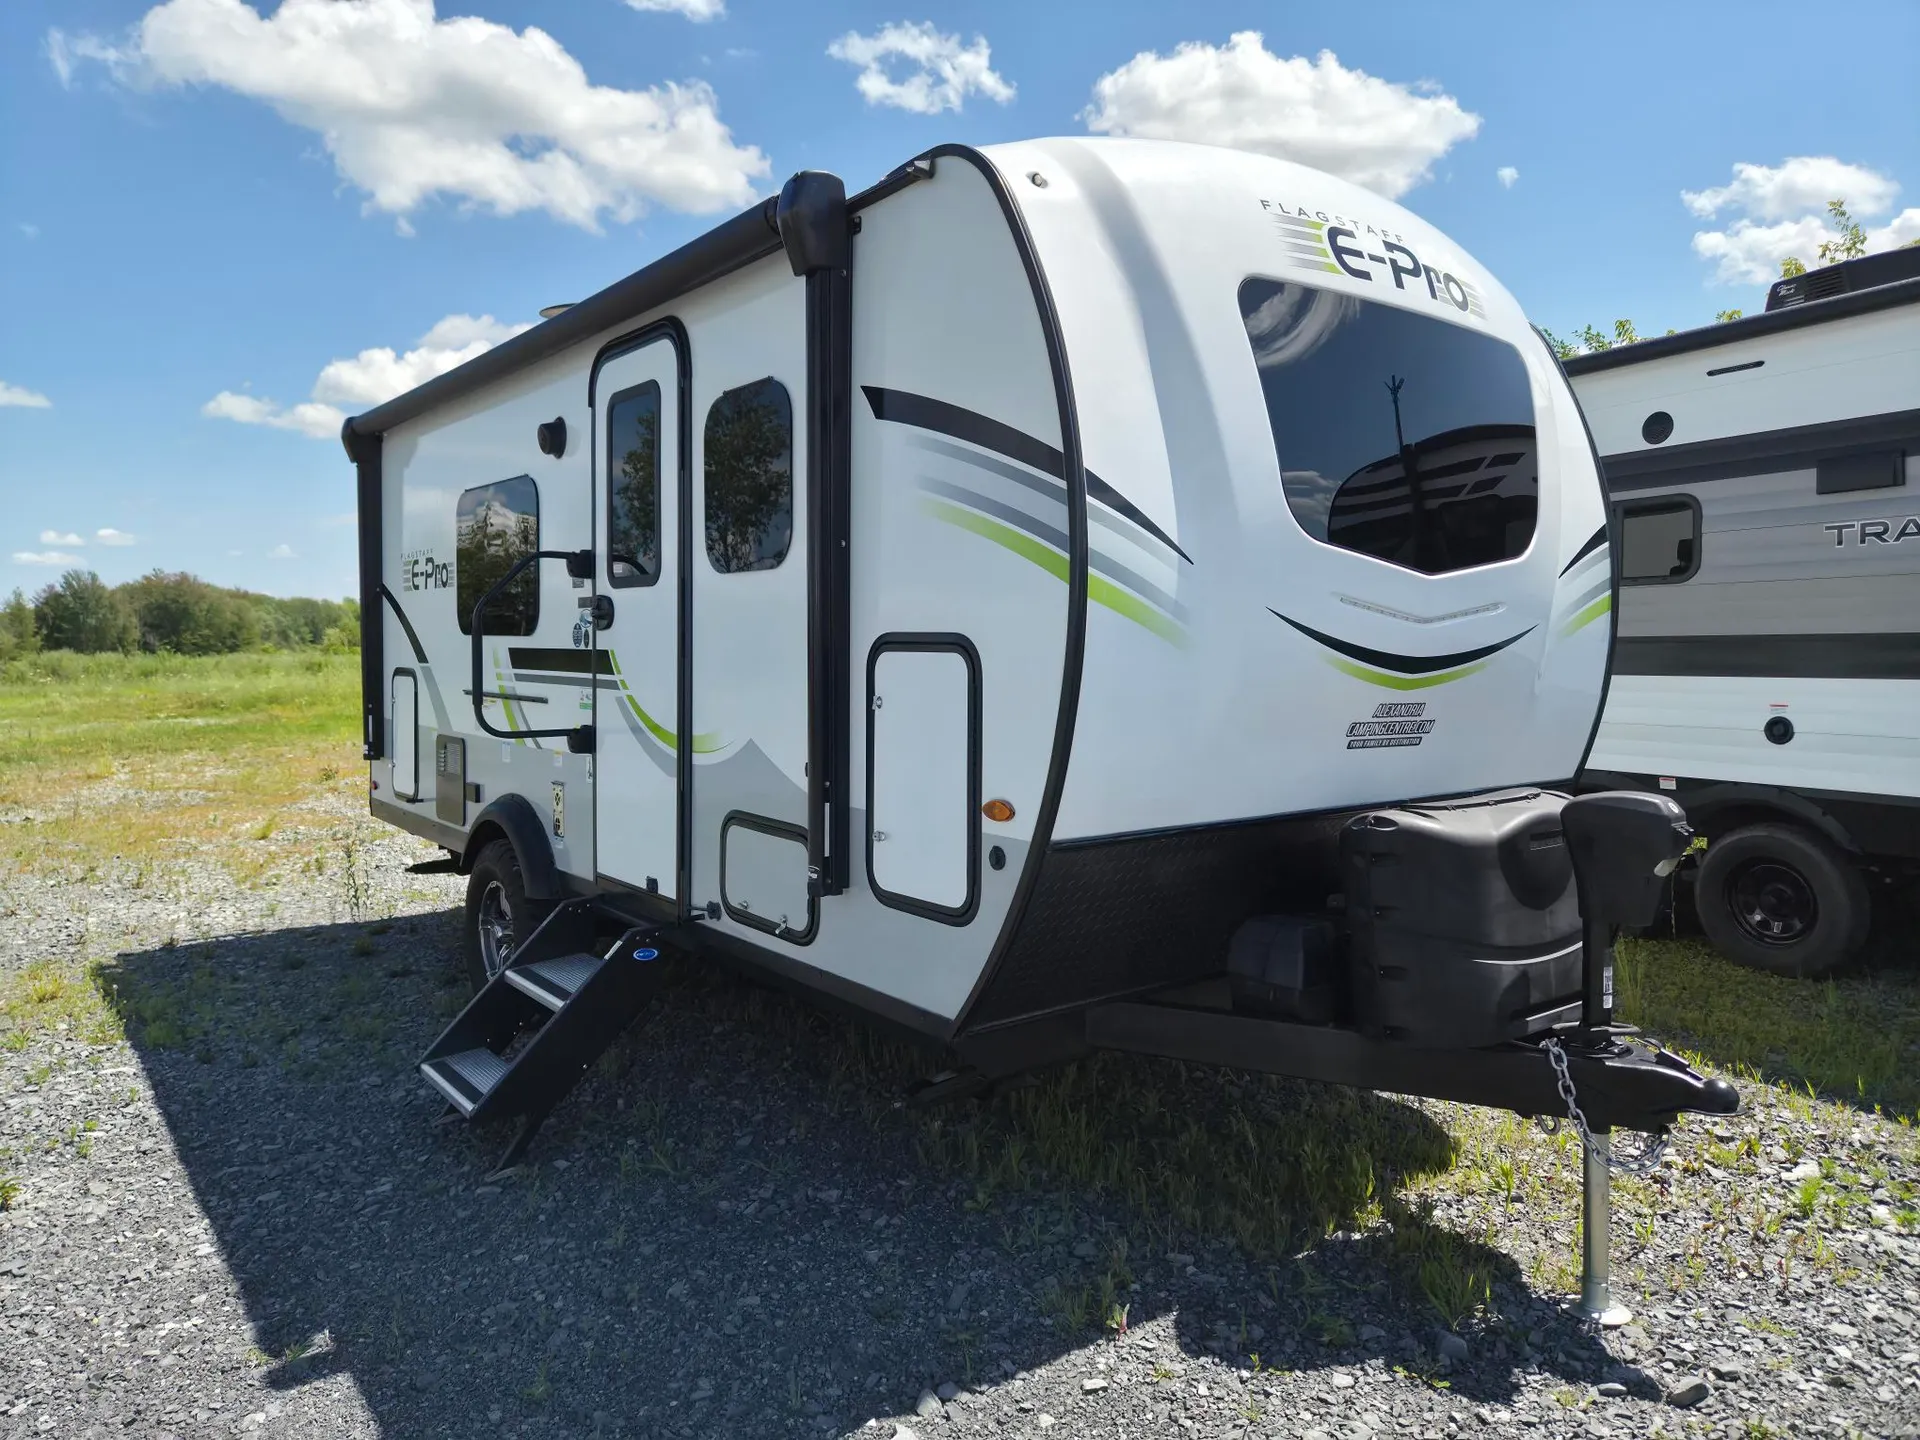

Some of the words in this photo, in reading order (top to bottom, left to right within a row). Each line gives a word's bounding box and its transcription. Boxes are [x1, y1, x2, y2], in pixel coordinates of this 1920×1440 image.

[1260, 199, 1404, 243] FLAGSTAFF
[1327, 226, 1469, 312] E-Pro
[1823, 516, 1920, 548] TRA
[412, 557, 449, 590] E-Pro
[1373, 702, 1426, 718] ALEXANDRIA
